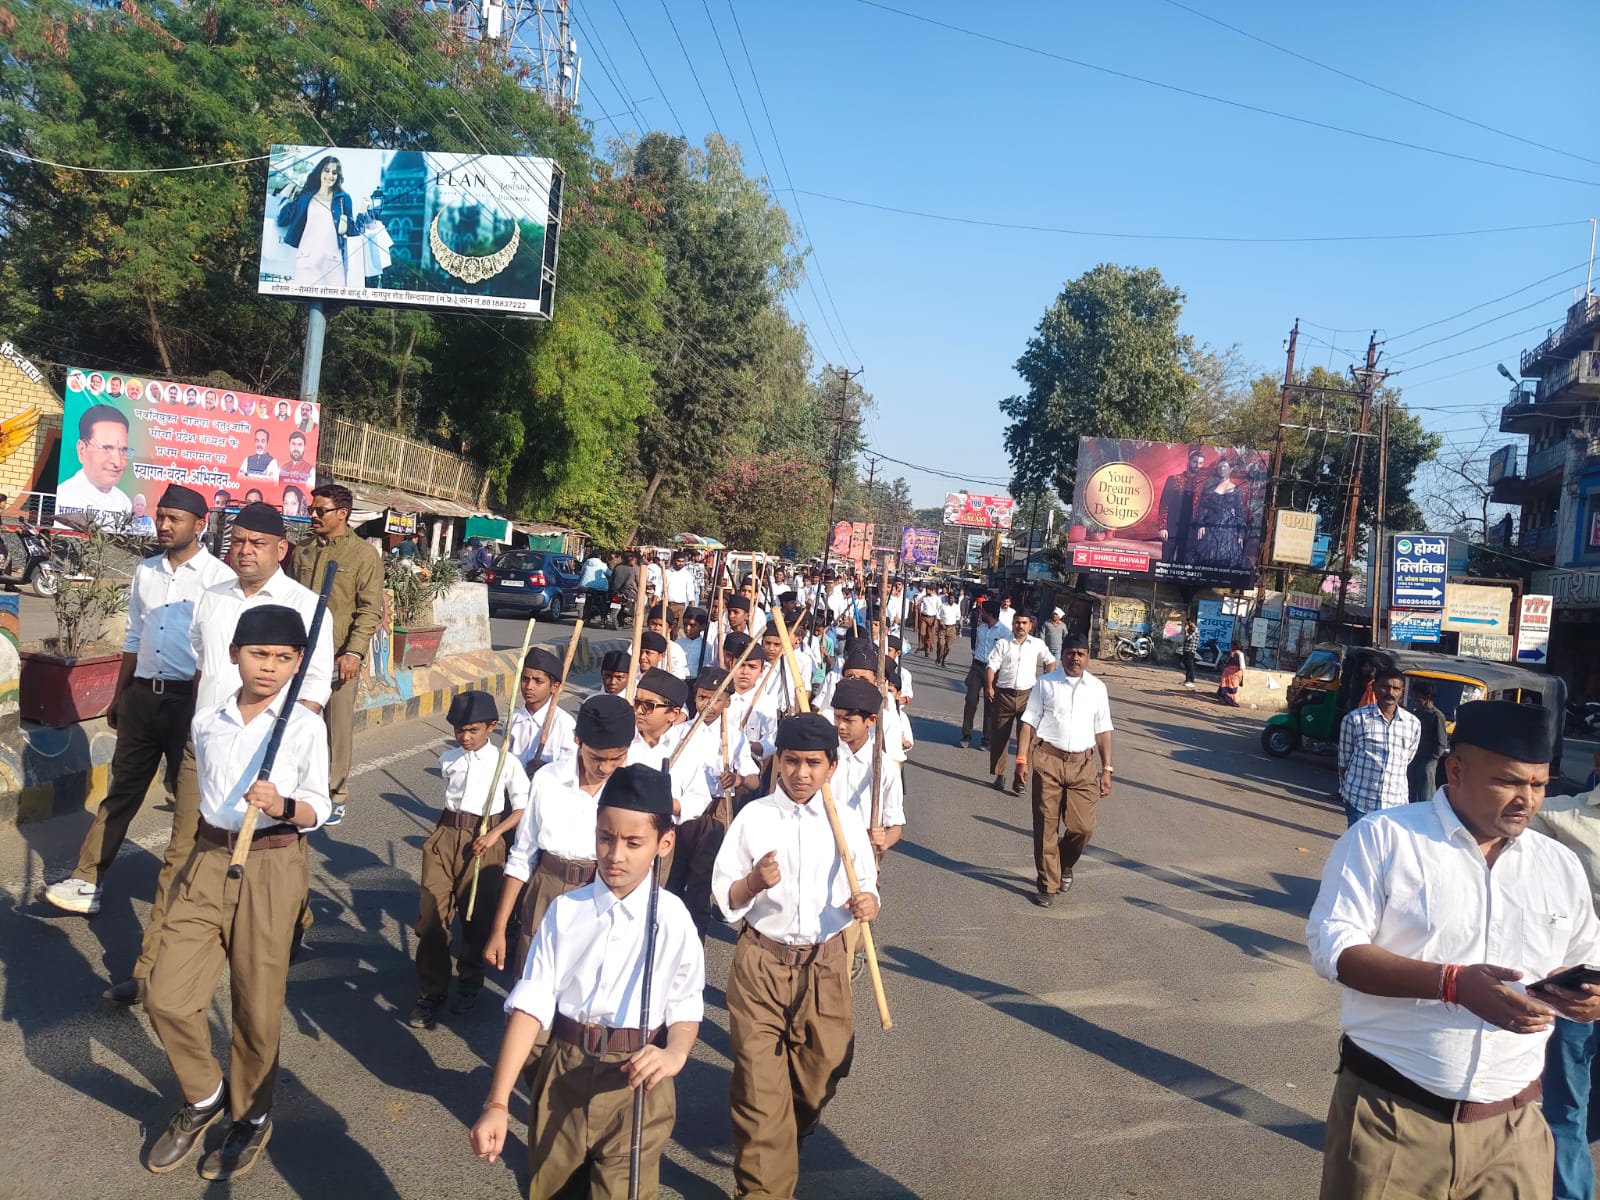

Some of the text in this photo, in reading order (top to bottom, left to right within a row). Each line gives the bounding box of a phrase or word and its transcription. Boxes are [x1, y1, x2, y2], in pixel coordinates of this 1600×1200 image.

[1108, 470, 1134, 484] Your
[1098, 480, 1140, 496] Dreams
[1106, 493, 1130, 506] Our
[1094, 502, 1140, 520] Designs
[1413, 538, 1446, 556] होम्यो
[1094, 554, 1117, 562] SHREE
[1118, 556, 1147, 565] SHIVAM
[1396, 557, 1446, 574] क्लिनिक
[1524, 597, 1551, 614] 777
[1200, 617, 1233, 631] रायपुर
